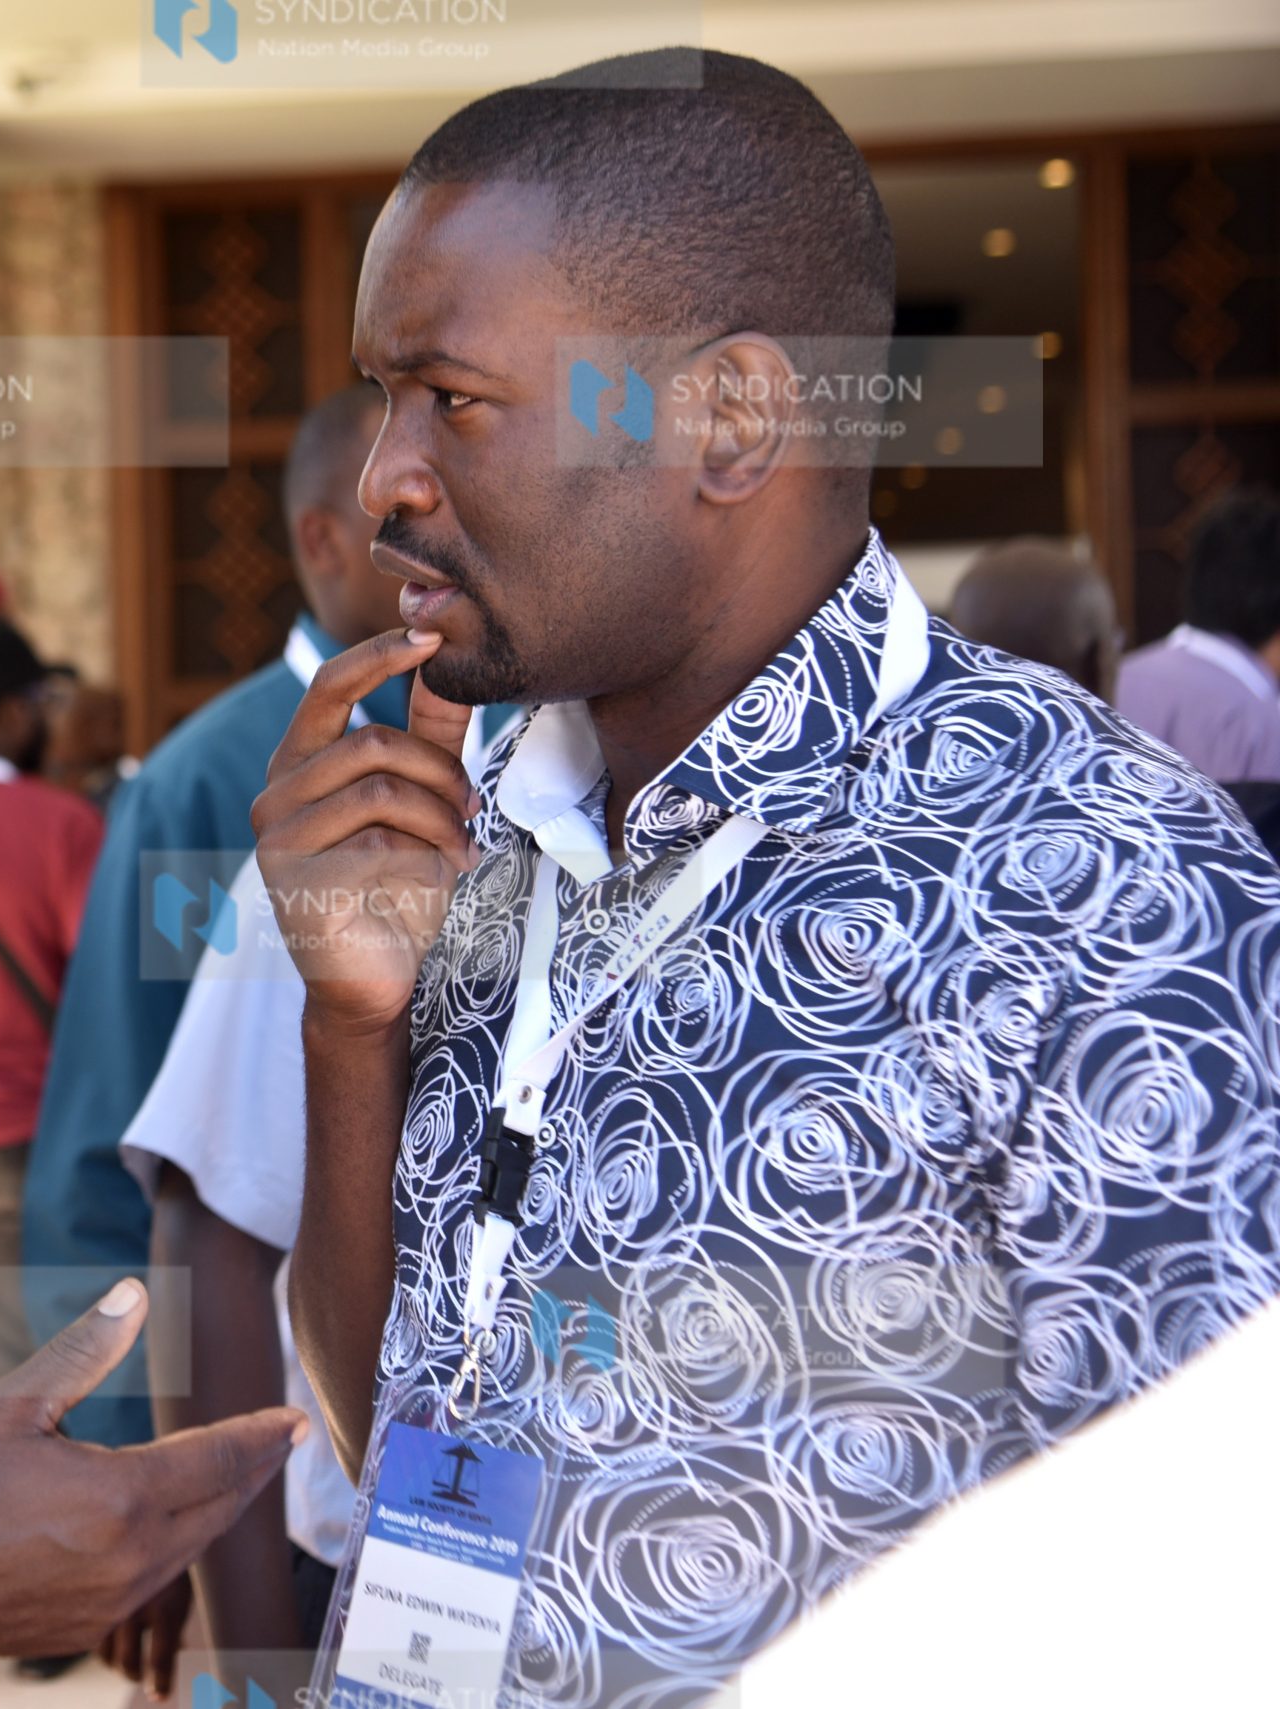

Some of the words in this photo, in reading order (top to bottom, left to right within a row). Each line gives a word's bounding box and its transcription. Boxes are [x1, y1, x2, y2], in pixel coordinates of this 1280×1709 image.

[376, 1503, 420, 1530] Annual
[419, 1515, 489, 1550] Conference
[488, 1533, 520, 1558] 2019
[363, 1581, 403, 1606] SIFUNA
[405, 1592, 444, 1617] EDWIN
[378, 1661, 443, 1697] DELEGATE
